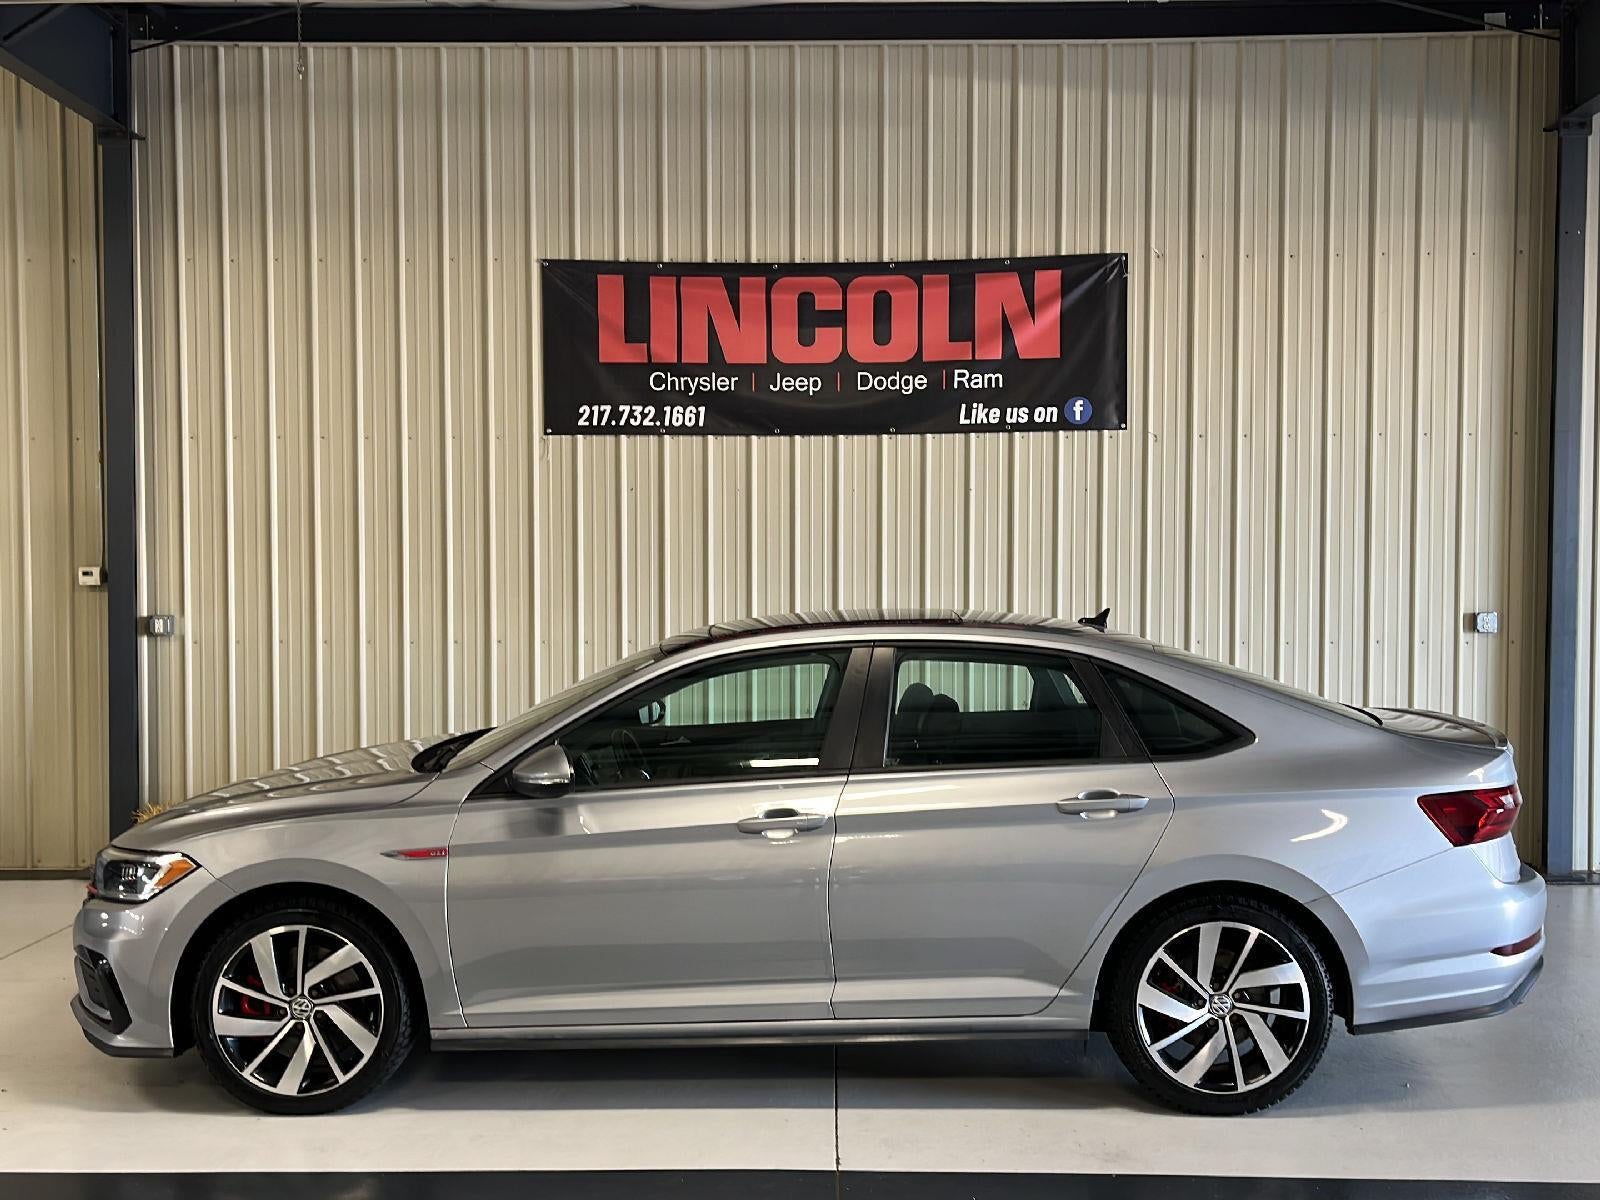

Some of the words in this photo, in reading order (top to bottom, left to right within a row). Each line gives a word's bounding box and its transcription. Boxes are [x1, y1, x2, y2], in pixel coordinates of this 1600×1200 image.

[597, 269, 1062, 364] LINCOLN
[649, 371, 738, 396] Chrysler
[769, 372, 822, 396] Jeep
[857, 371, 928, 394] Dodge
[954, 369, 1003, 390] Ram
[577, 404, 706, 427] 217.732.1661
[959, 403, 1001, 426] Like
[1006, 407, 1029, 424] us
[1034, 406, 1058, 423] on
